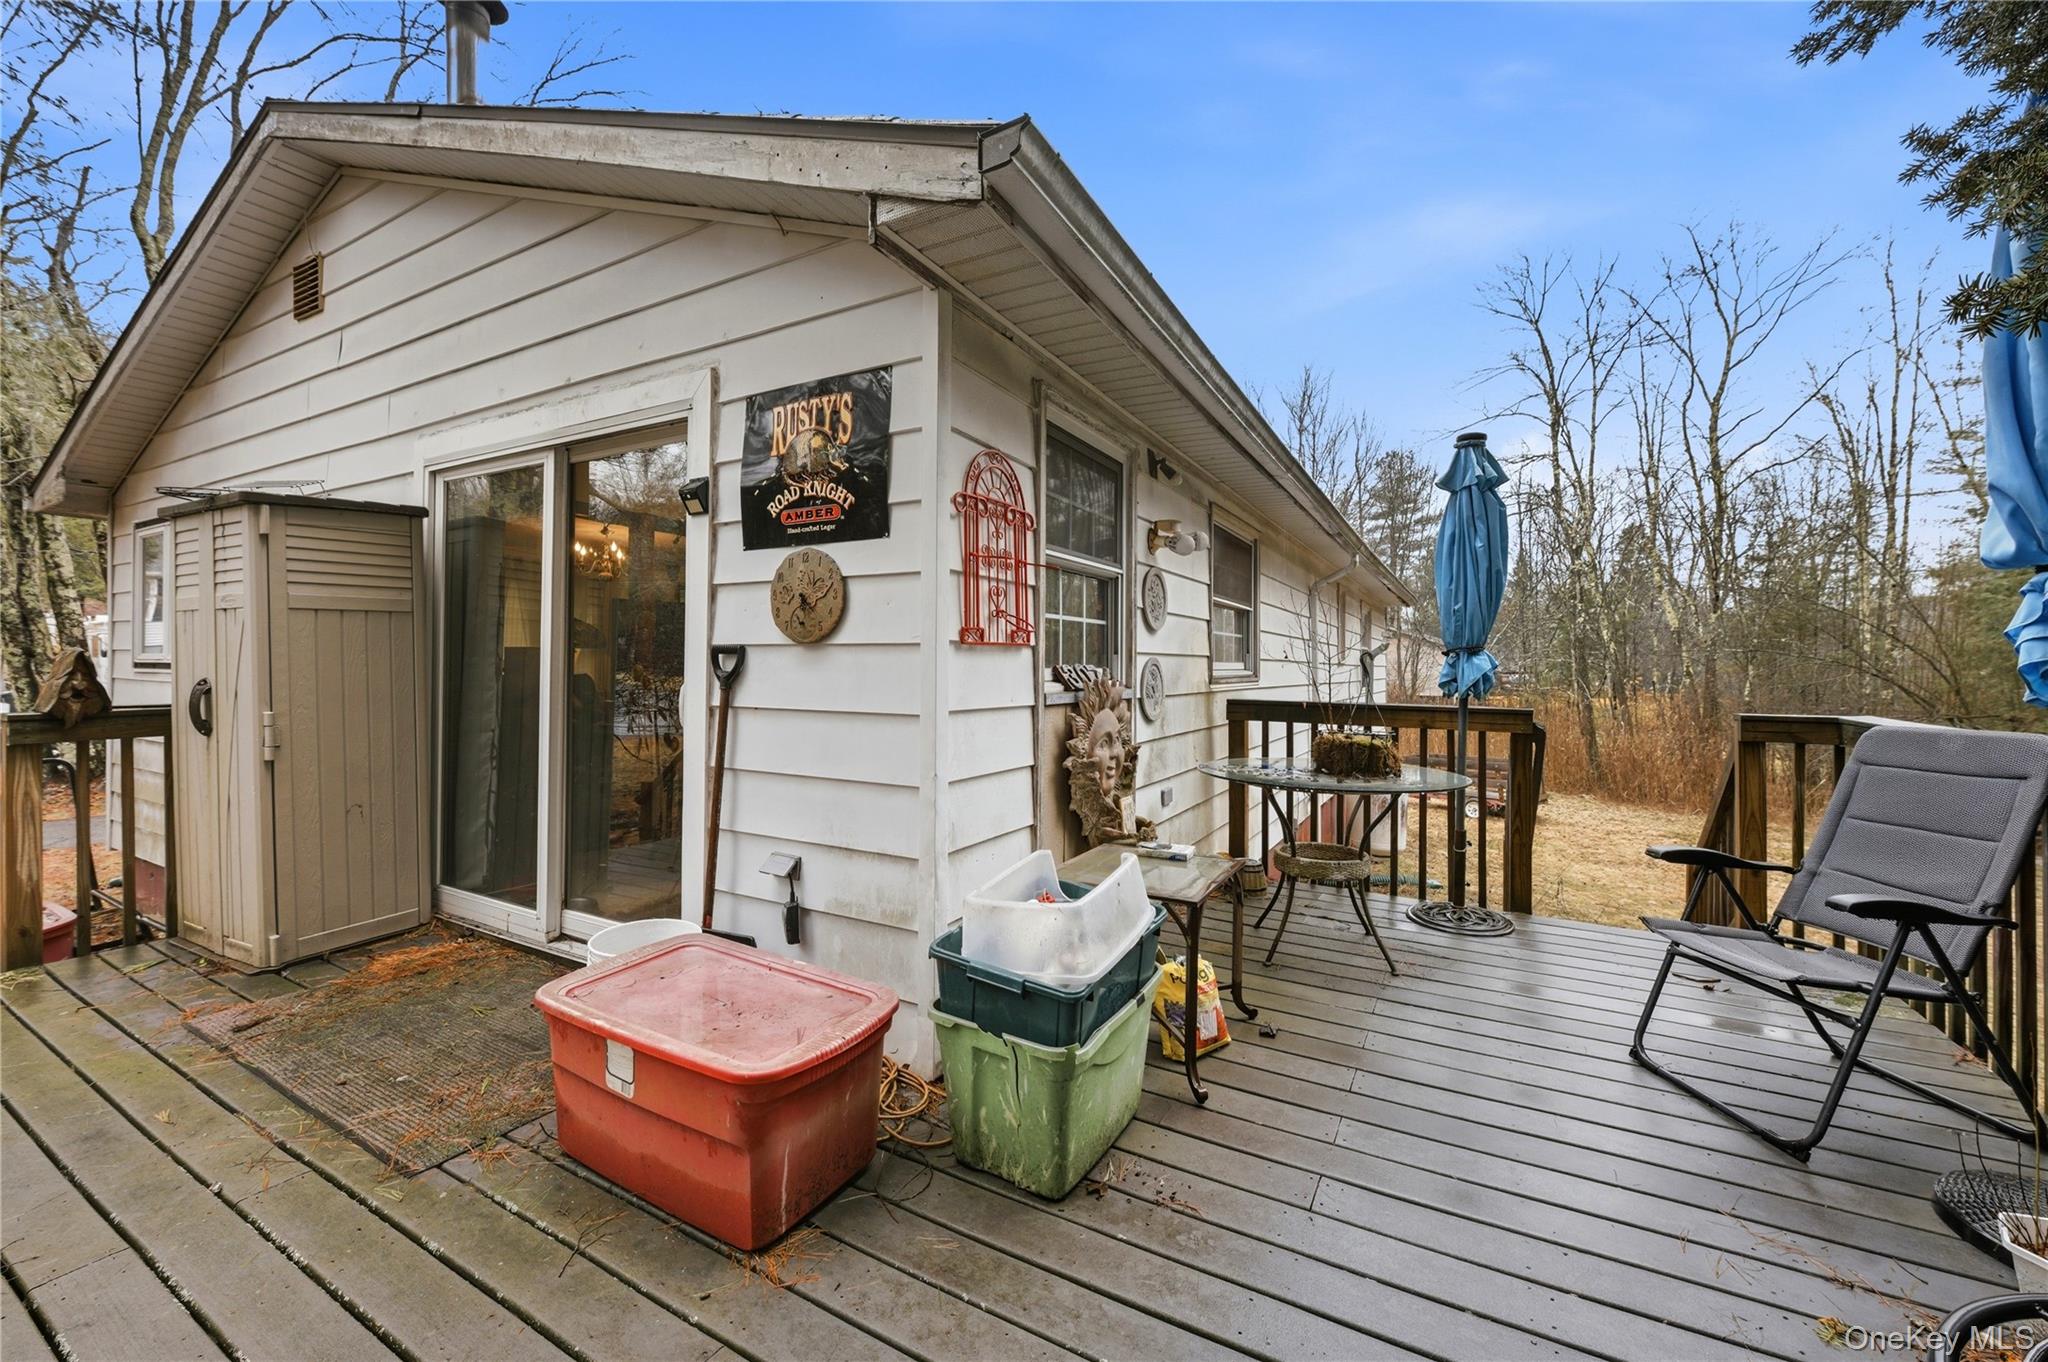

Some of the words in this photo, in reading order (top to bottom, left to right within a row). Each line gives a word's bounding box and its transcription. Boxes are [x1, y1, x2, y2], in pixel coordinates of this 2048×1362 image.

[771, 391, 853, 457] RUSTY'S
[766, 486, 800, 518] ROAD
[803, 480, 855, 510] KNIGHT
[785, 508, 834, 521] AMBER
[802, 552, 809, 563] 12
